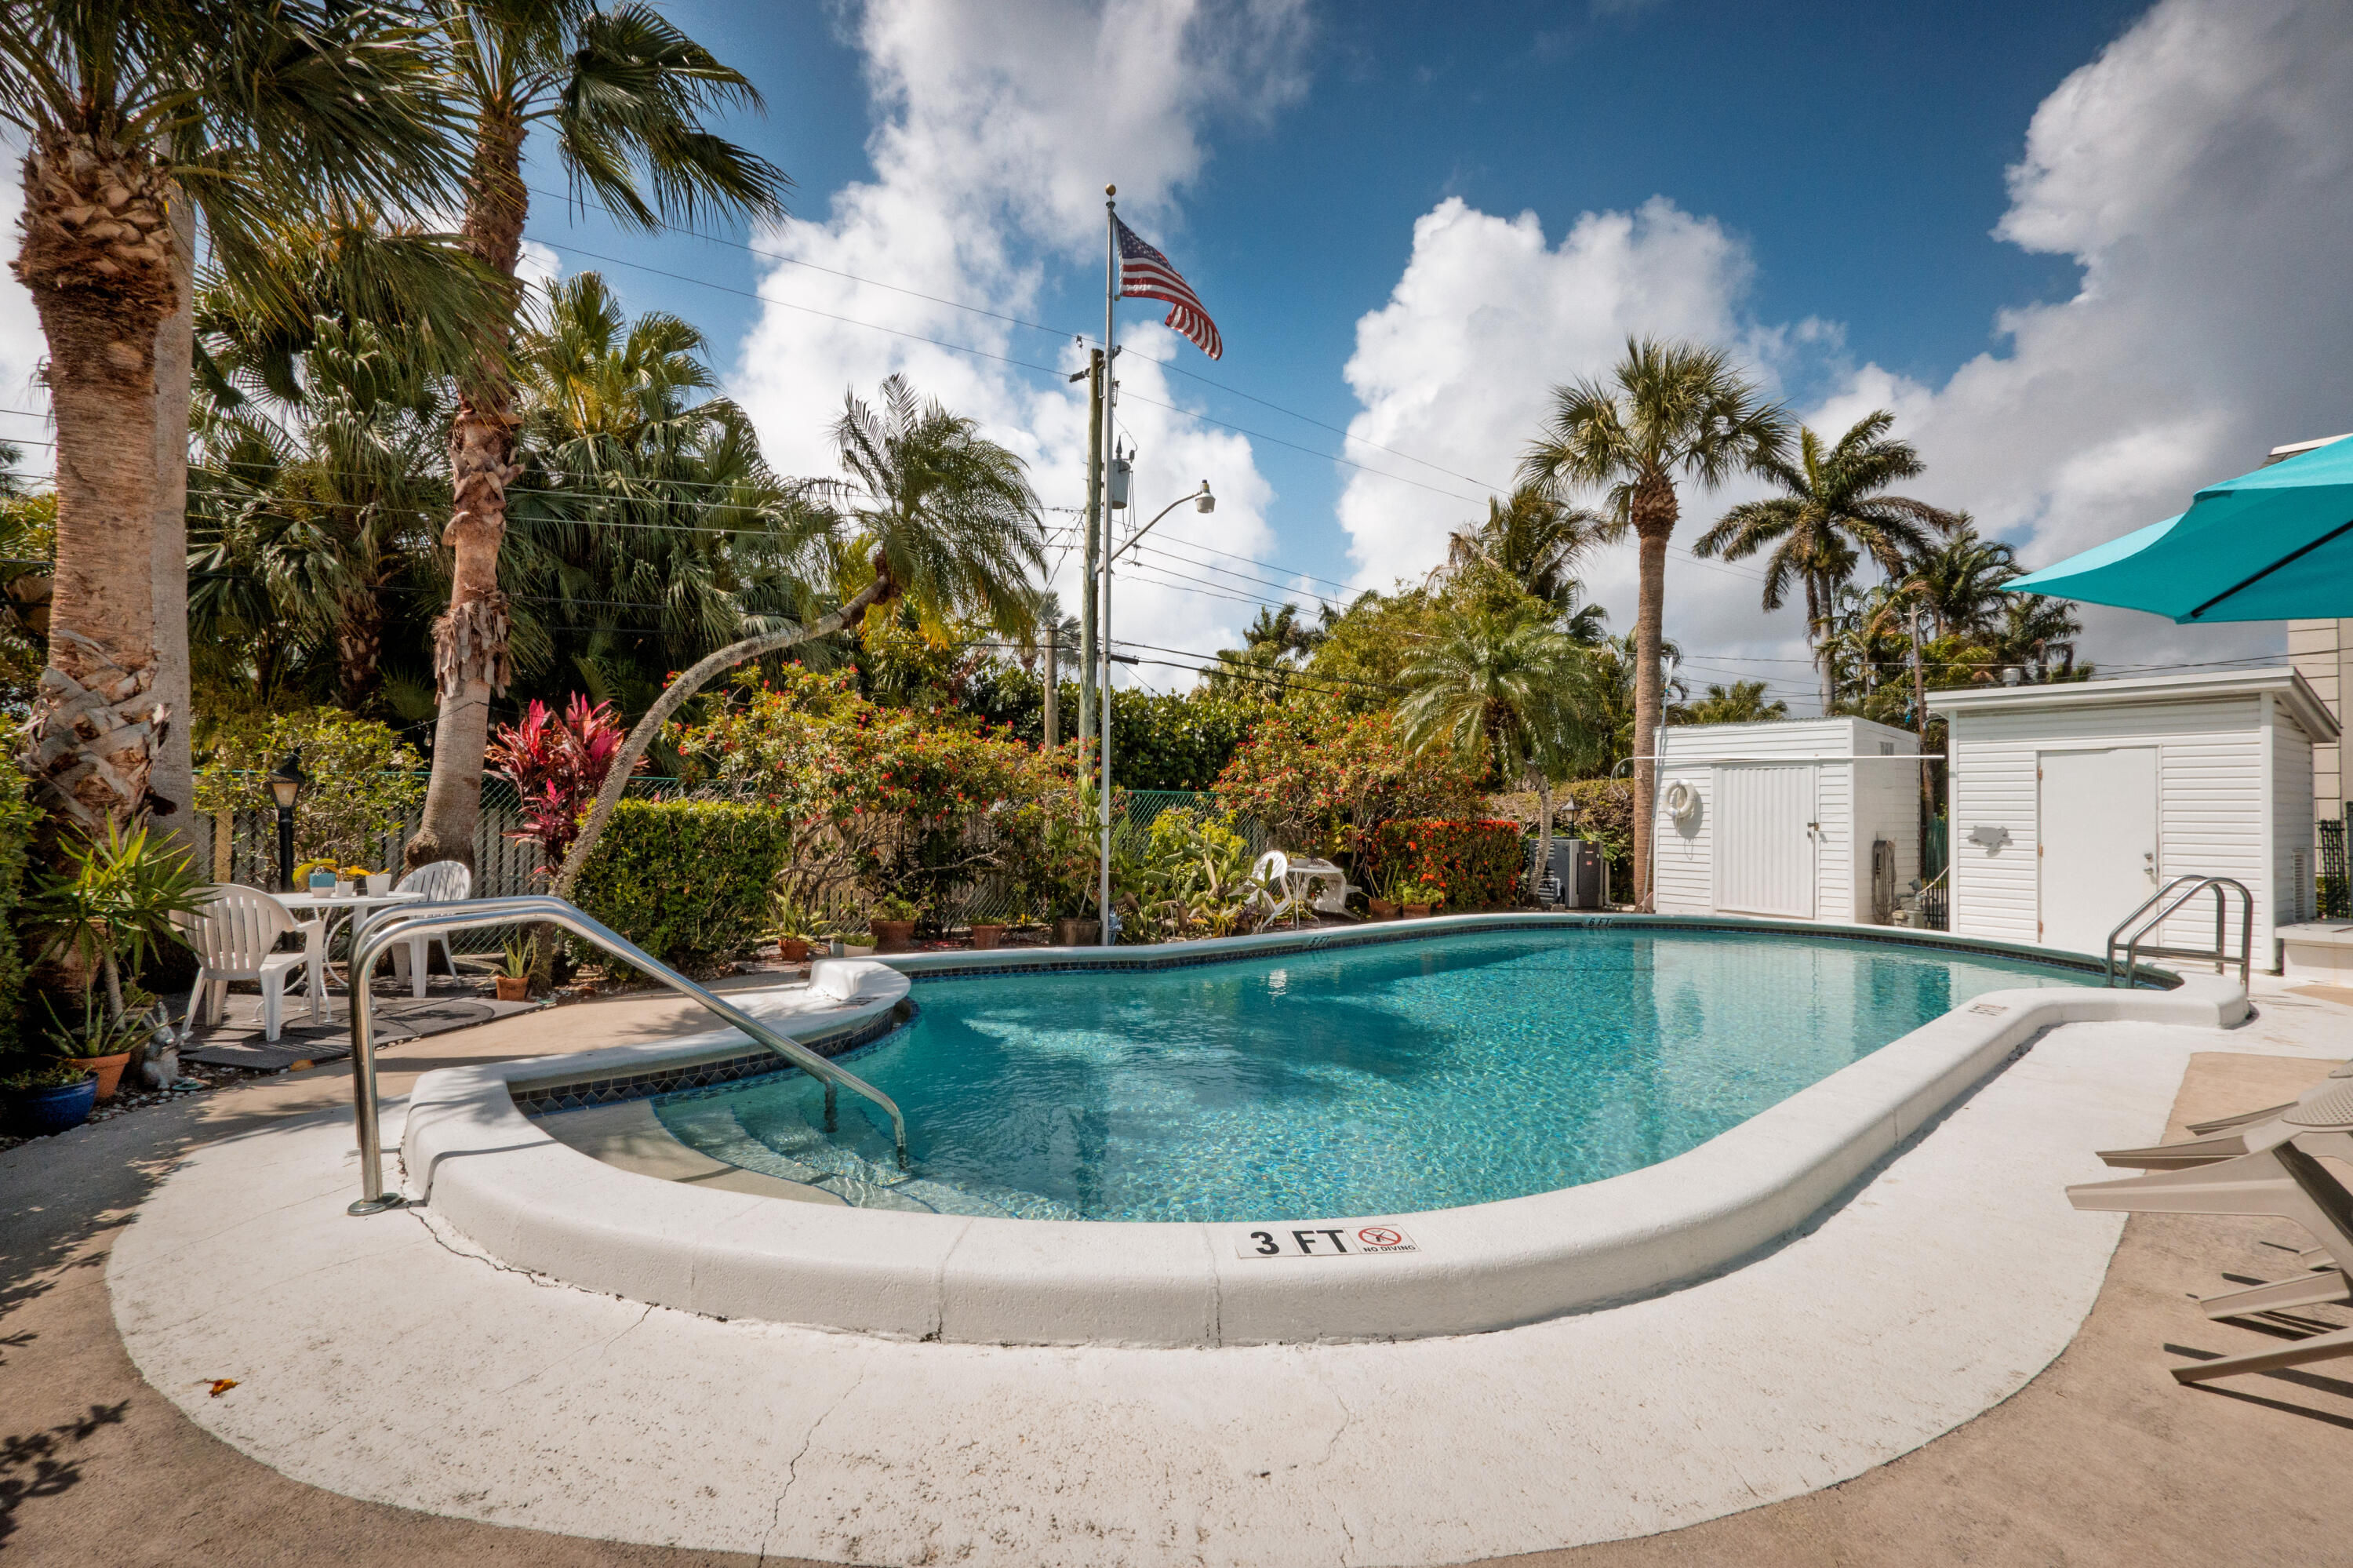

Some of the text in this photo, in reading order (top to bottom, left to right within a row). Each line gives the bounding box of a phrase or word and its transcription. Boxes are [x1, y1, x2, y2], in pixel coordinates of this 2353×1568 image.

[1588, 918, 1613, 926] 6 FT
[1315, 936, 1332, 948] FT
[1250, 1229, 1347, 1255] 3 FT
